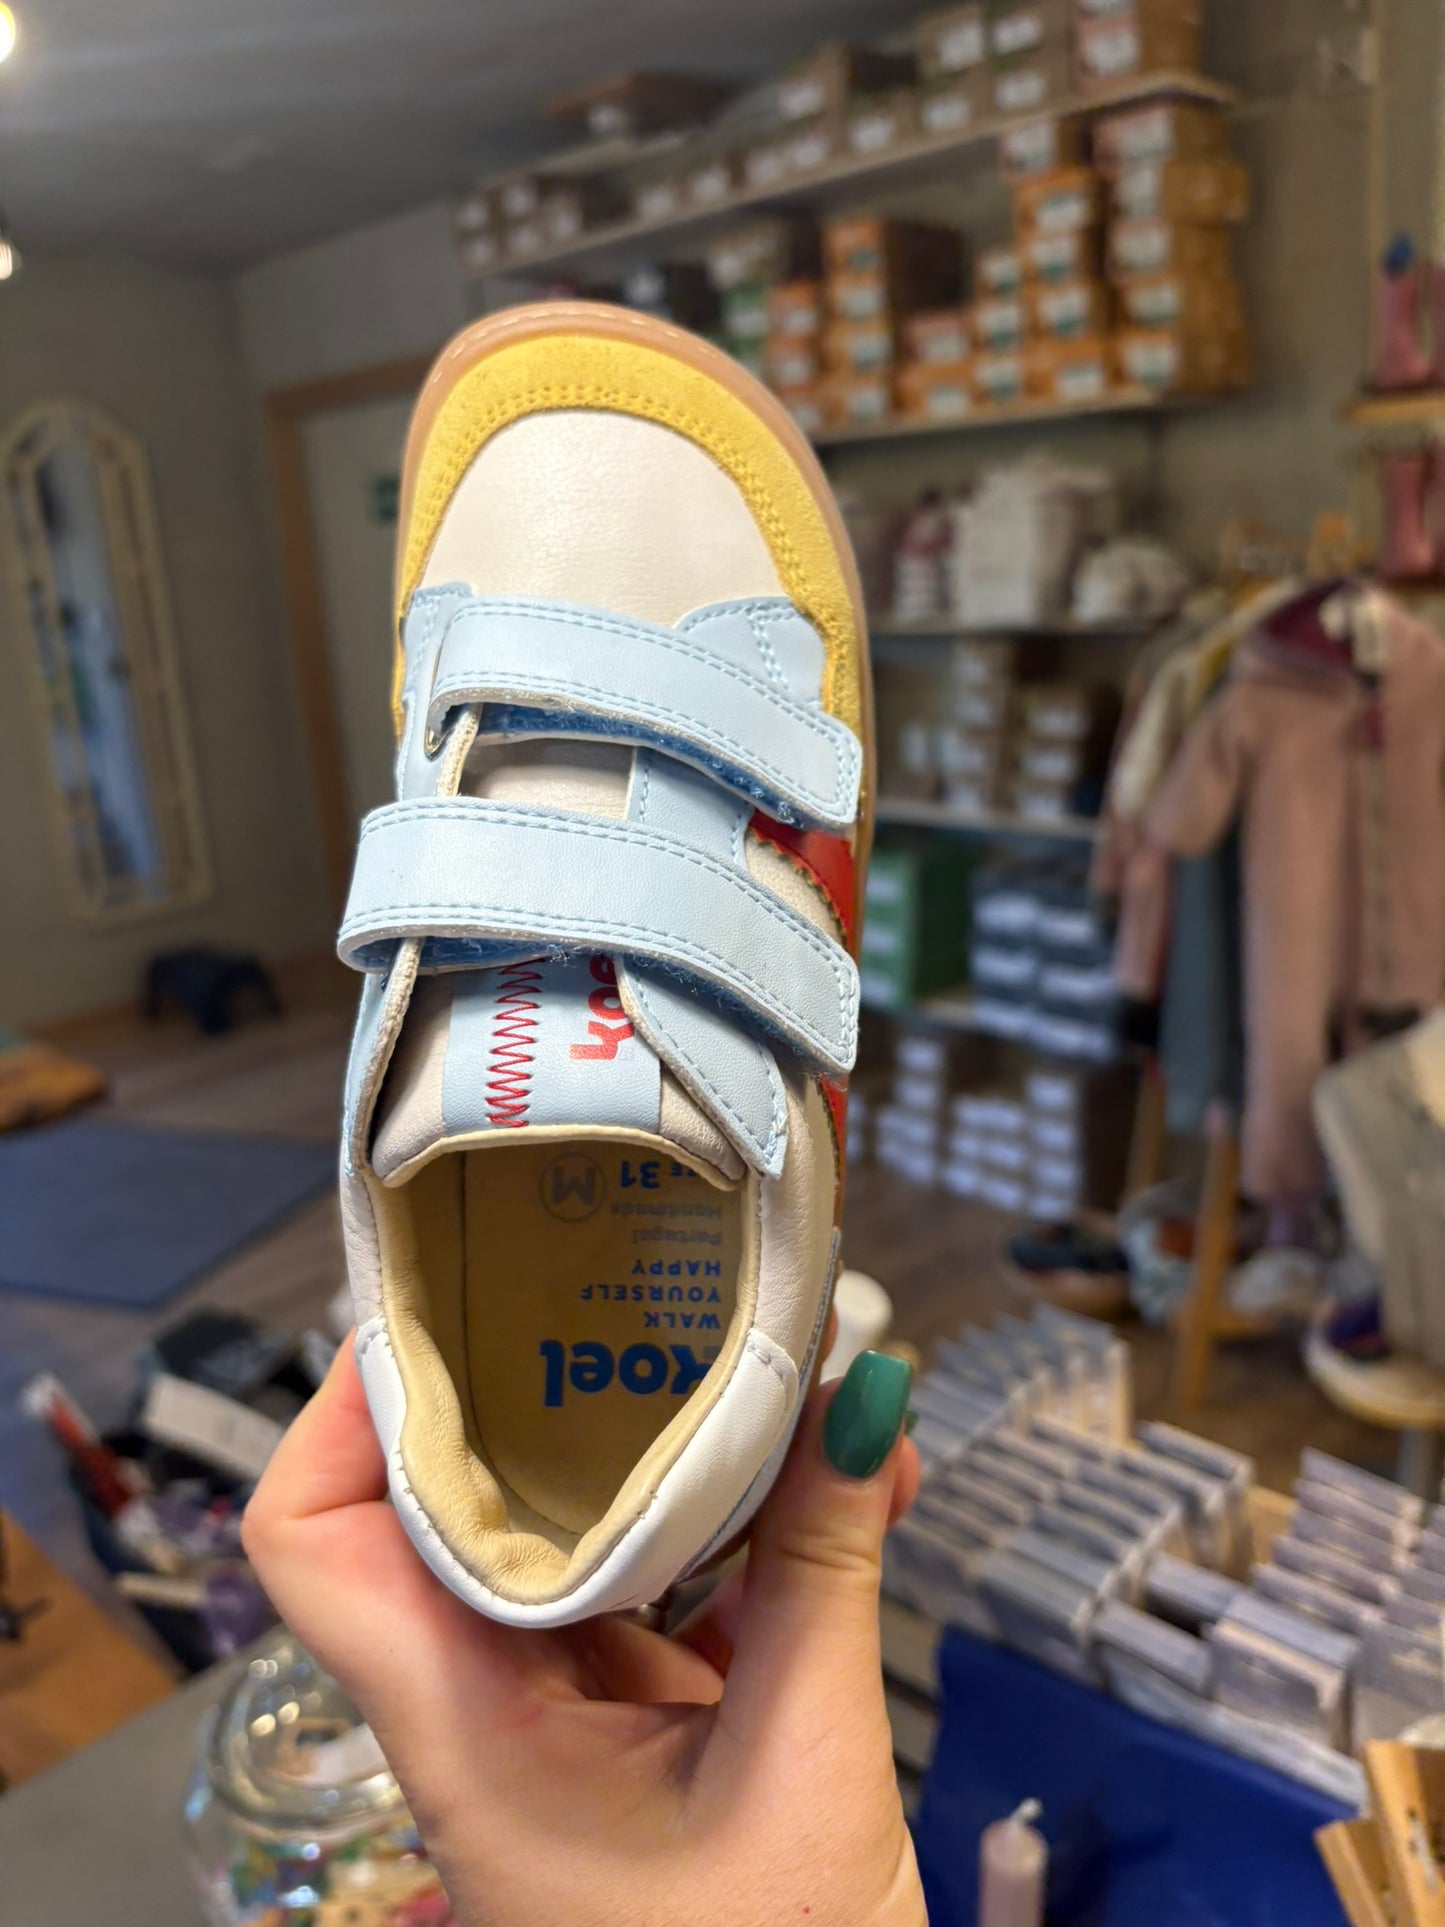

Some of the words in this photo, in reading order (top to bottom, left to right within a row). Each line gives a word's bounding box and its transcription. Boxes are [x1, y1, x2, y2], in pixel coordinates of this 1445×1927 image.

[621, 1160, 660, 1189] 31
[553, 1166, 596, 1205] M
[611, 1203, 721, 1218] Handmade
[633, 1226, 721, 1245] Portugal
[631, 1259, 721, 1277] HAPPY
[581, 1284, 721, 1303] YOURSELF
[643, 1312, 721, 1329] WALK
